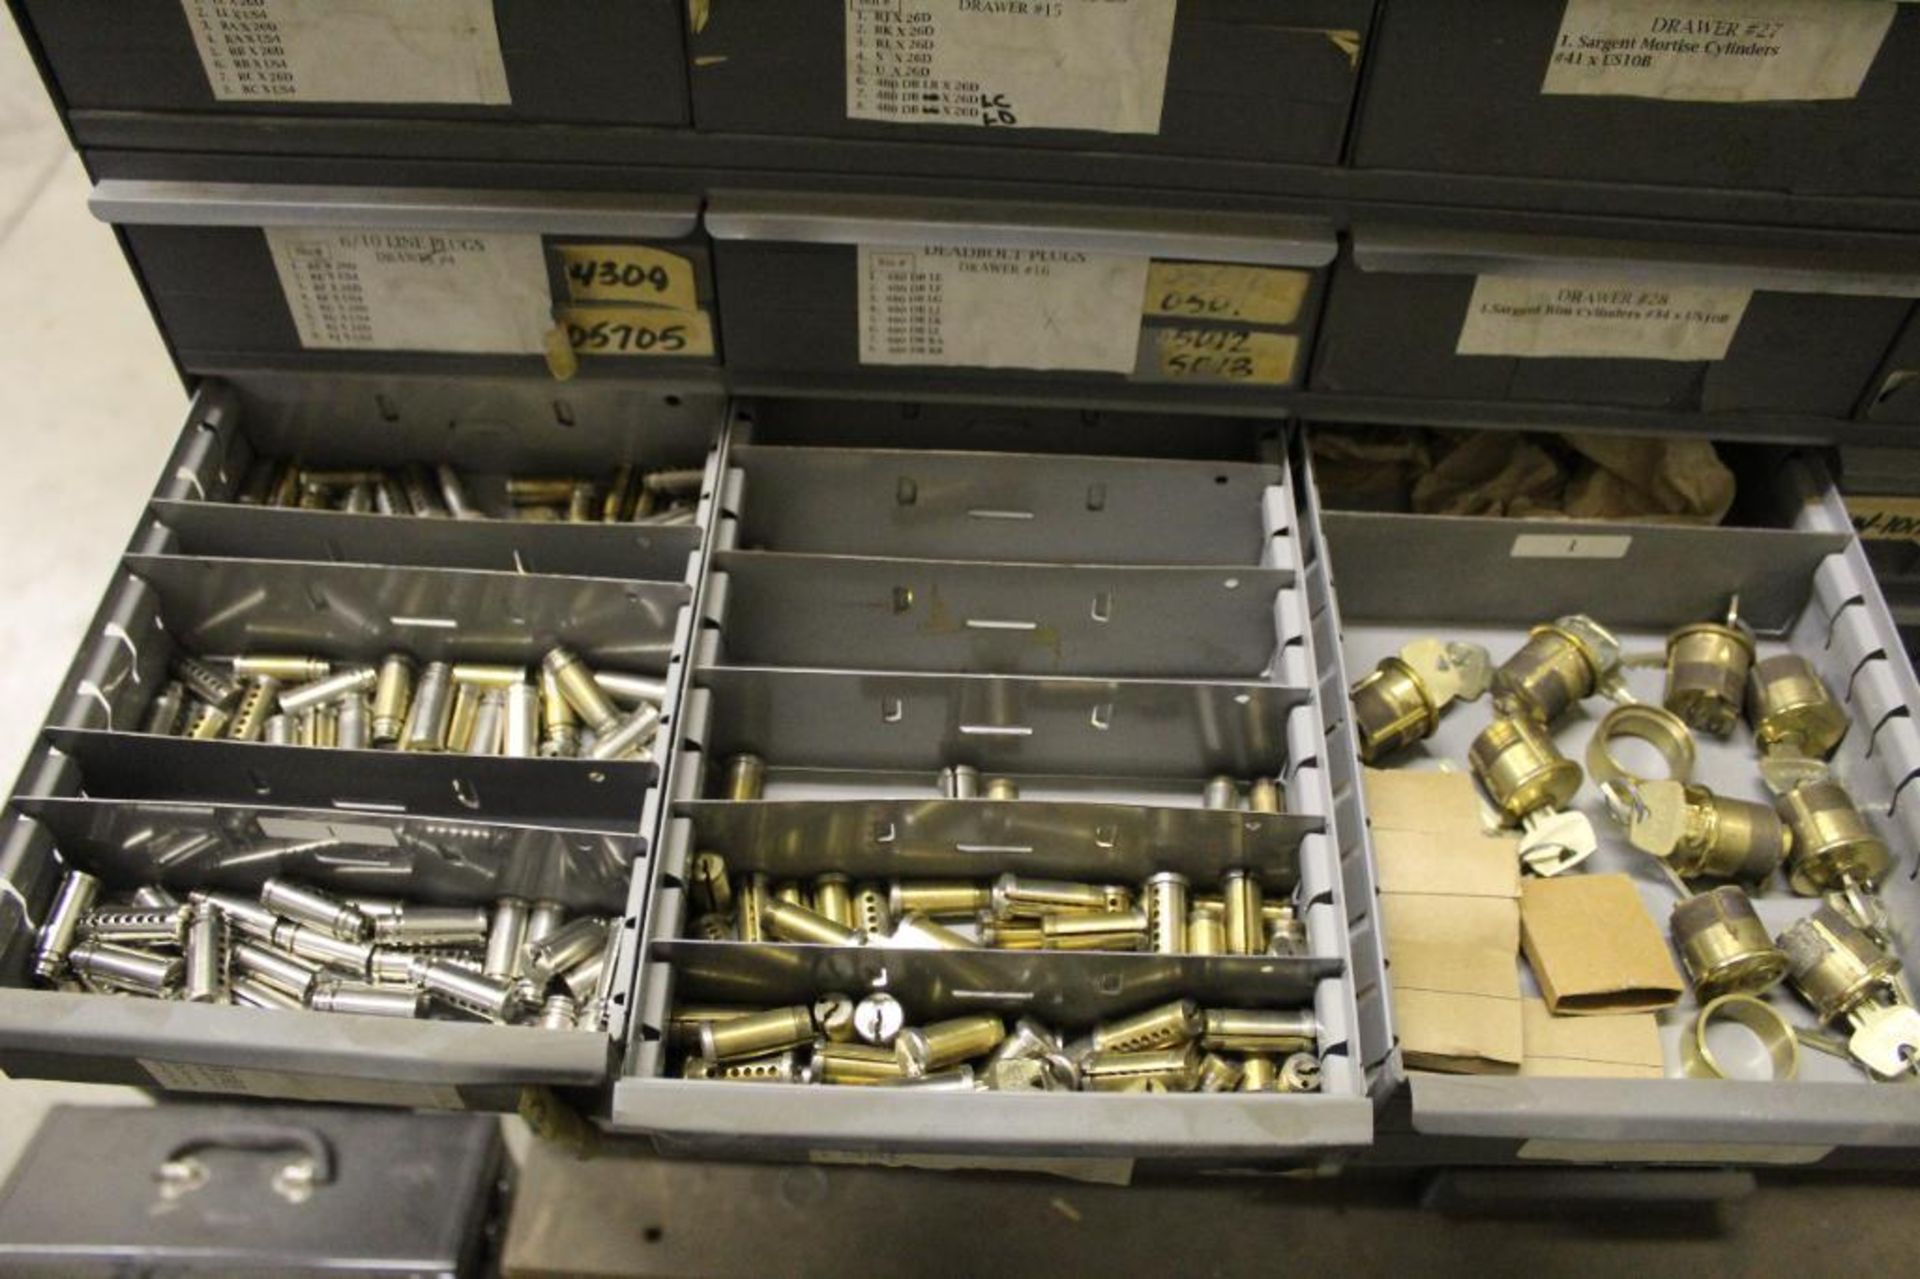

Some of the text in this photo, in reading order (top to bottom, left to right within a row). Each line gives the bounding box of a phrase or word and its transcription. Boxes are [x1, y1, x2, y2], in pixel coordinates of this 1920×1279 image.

[958, 0, 1061, 18] DRAWER #15
[906, 13, 932, 23] 26D
[908, 26, 935, 36] 26D
[1651, 17, 1785, 39] DRAWER #27
[909, 39, 934, 50] 26D
[1561, 34, 1780, 58] 1. Sargent Mortise Cylinders
[906, 53, 932, 63] 26D
[1555, 52, 1583, 65] #41
[1602, 53, 1652, 68] US10B
[905, 66, 931, 76] 26D
[925, 245, 1087, 263] DEADBOLT PLUGS
[959, 261, 1018, 275] DRAWER
[569, 261, 669, 292] 4309
[1557, 288, 1631, 304] DRAWER
[1576, 306, 1640, 319] Cylinders
